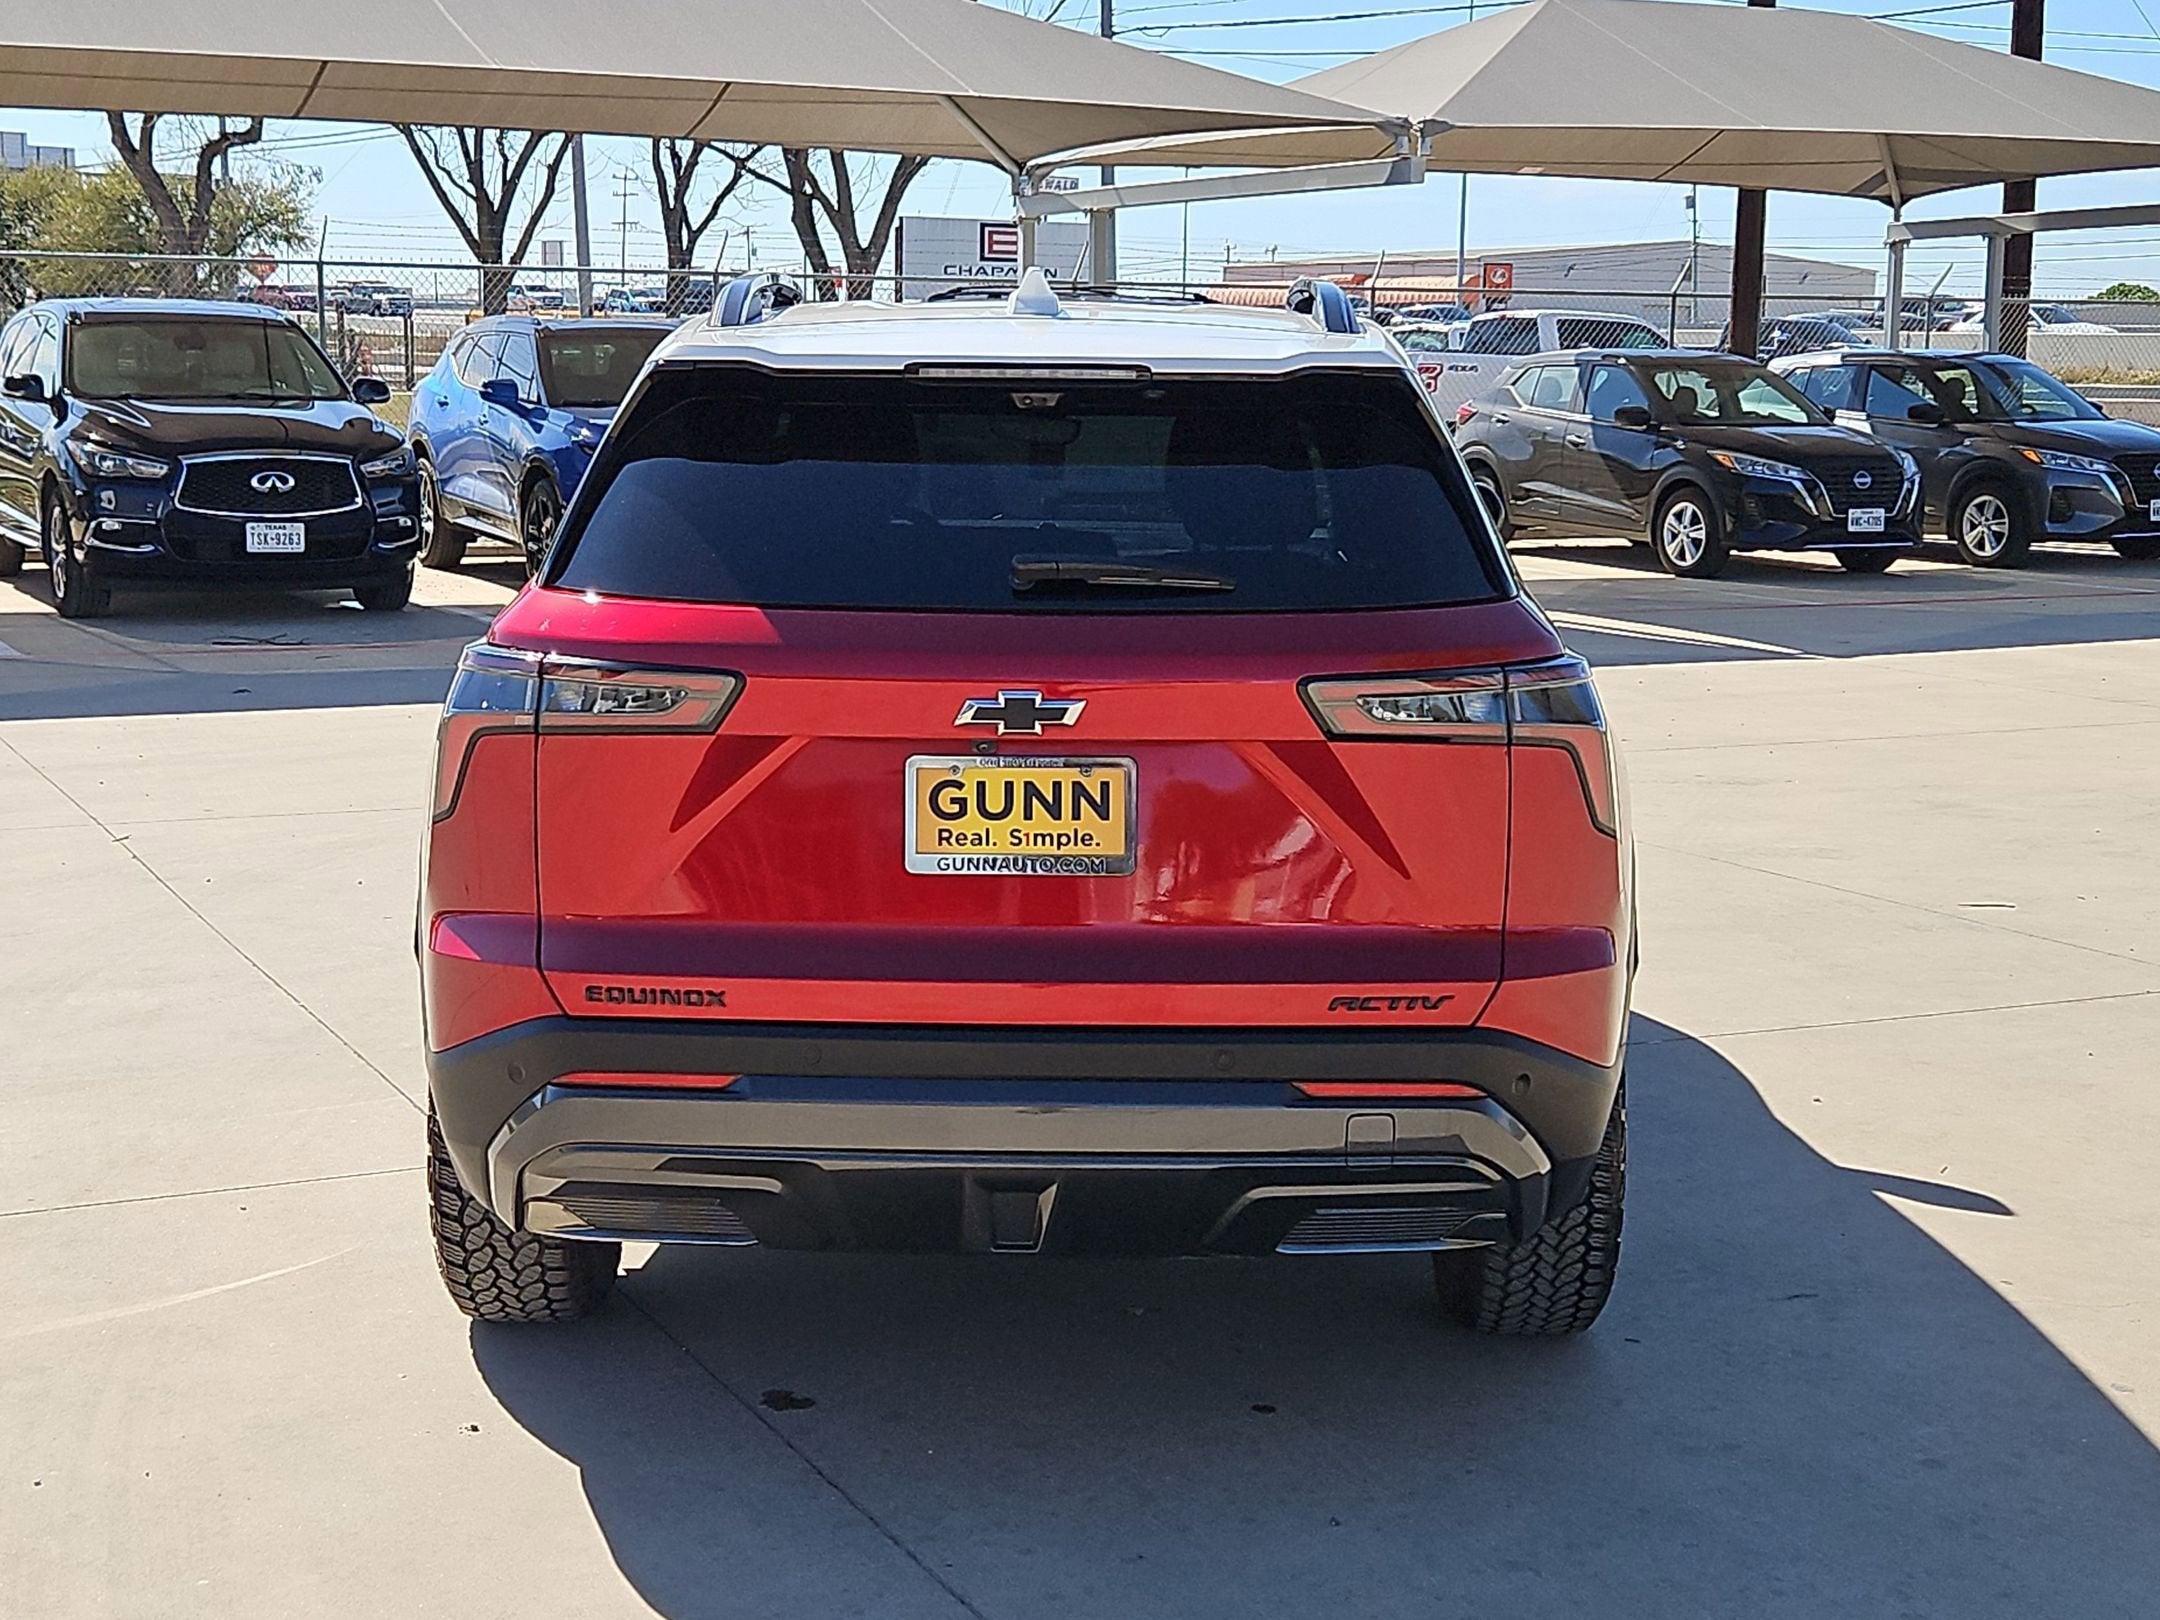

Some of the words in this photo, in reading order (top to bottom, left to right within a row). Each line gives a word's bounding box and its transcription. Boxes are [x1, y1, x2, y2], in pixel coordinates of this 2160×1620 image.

[1039, 178, 1077, 191] WALD
[943, 265, 1058, 279] CHAPMN
[928, 779, 1110, 821] GUNN
[937, 828, 997, 847] Real.
[937, 857, 1106, 873] GUNNAUTO.COM
[585, 985, 727, 1007] EQUINOX
[1328, 994, 1456, 1011] ACTIV
